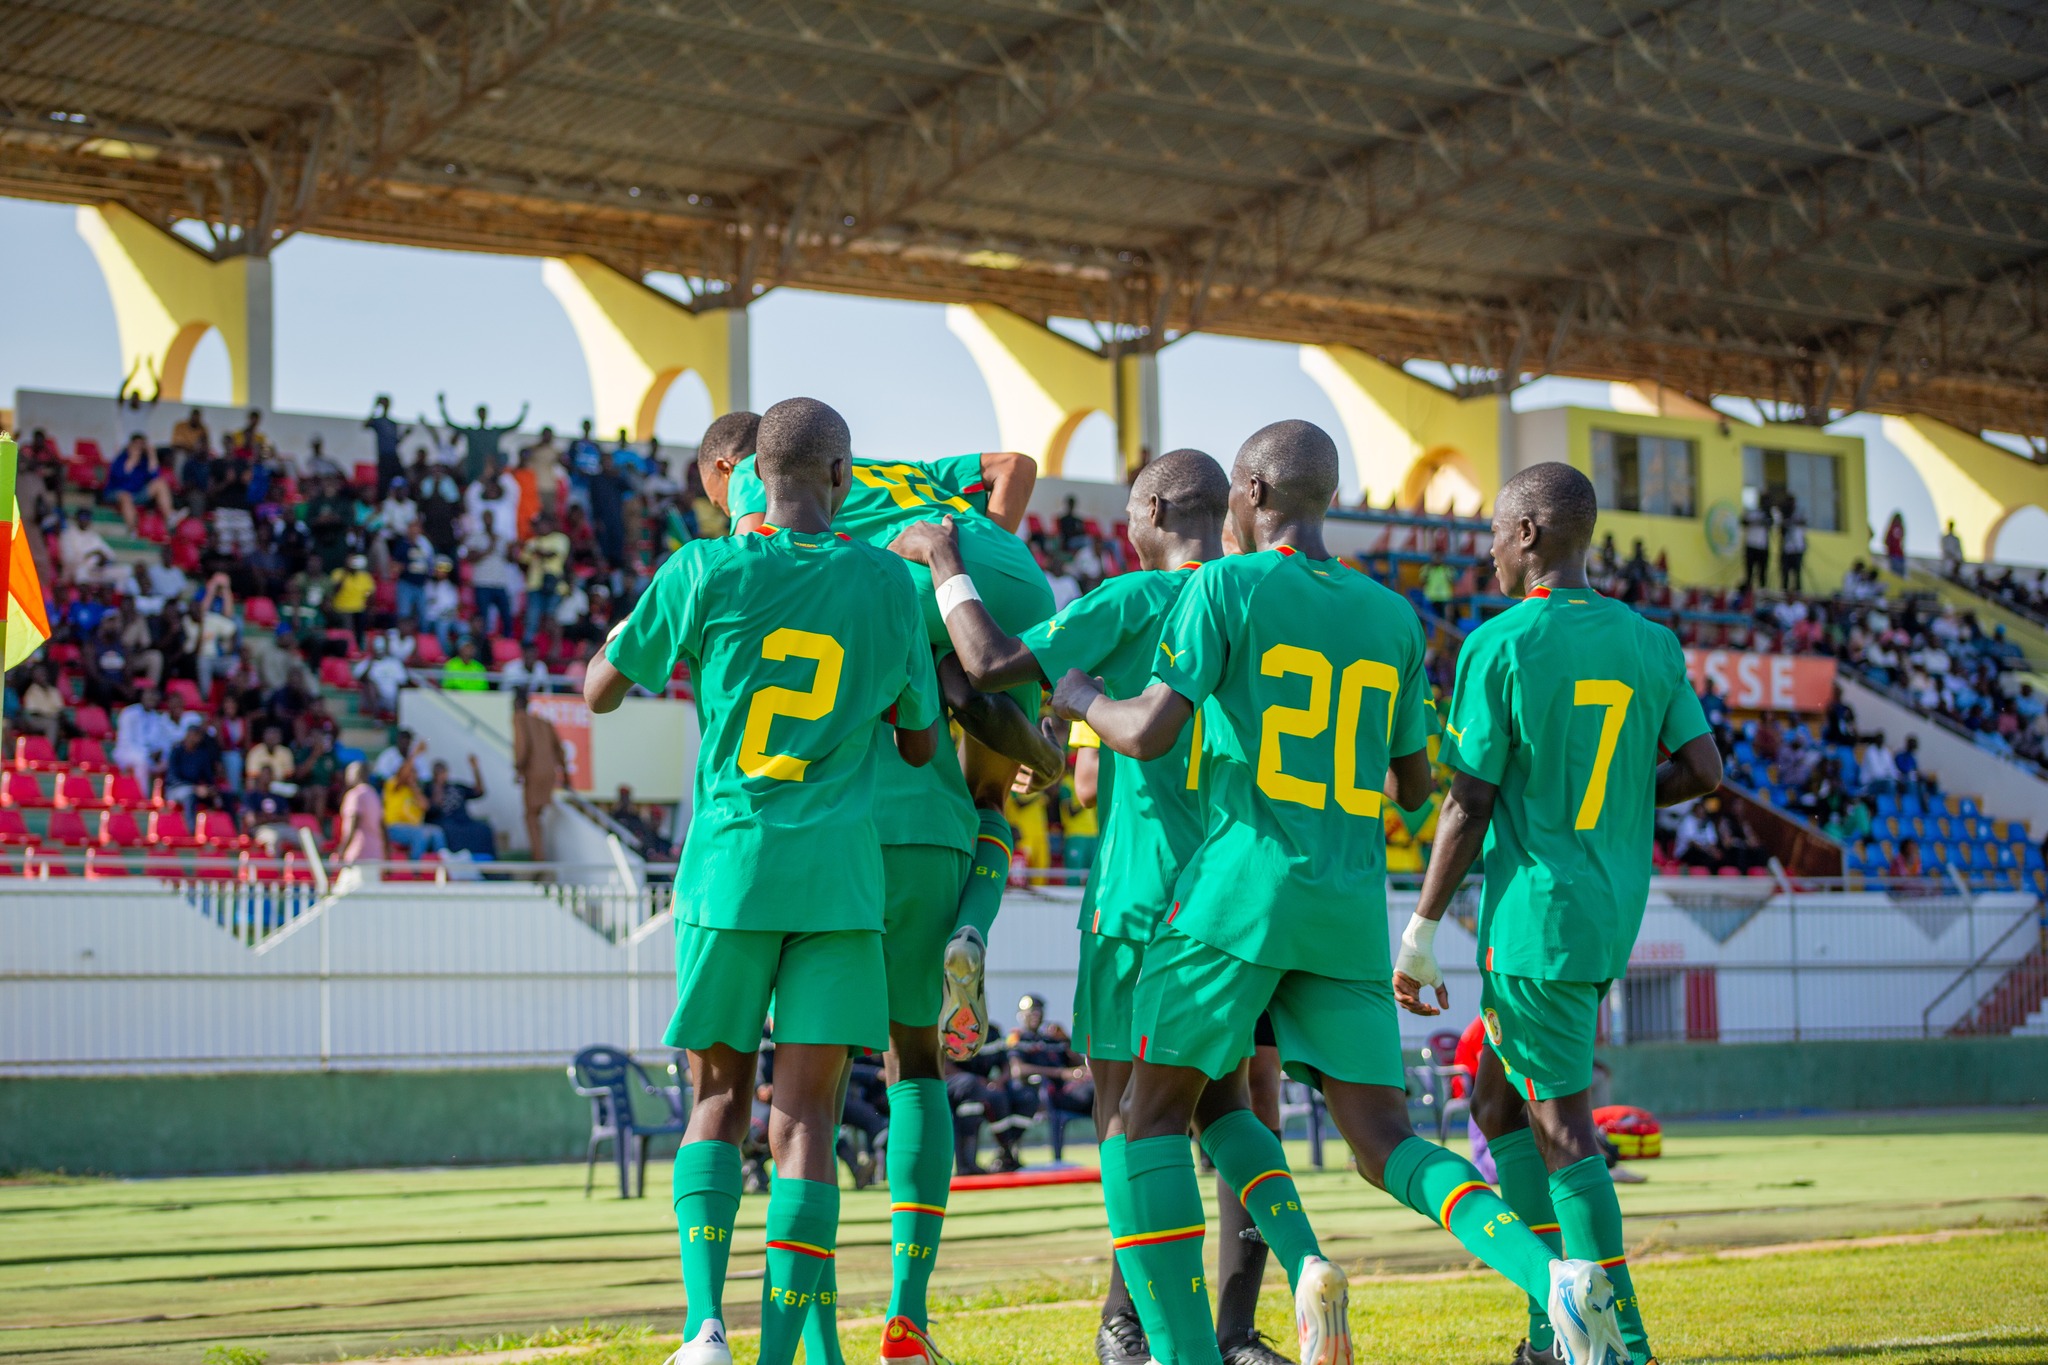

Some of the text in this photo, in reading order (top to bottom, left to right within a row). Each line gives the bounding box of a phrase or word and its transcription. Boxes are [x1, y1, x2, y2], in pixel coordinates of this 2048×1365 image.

[738, 627, 844, 781] 2
[1257, 644, 1400, 818] 20
[1573, 679, 1634, 830] 7
[689, 1225, 727, 1243] FSF
[894, 1242, 932, 1259] FSF
[769, 1286, 810, 1308] FSF
